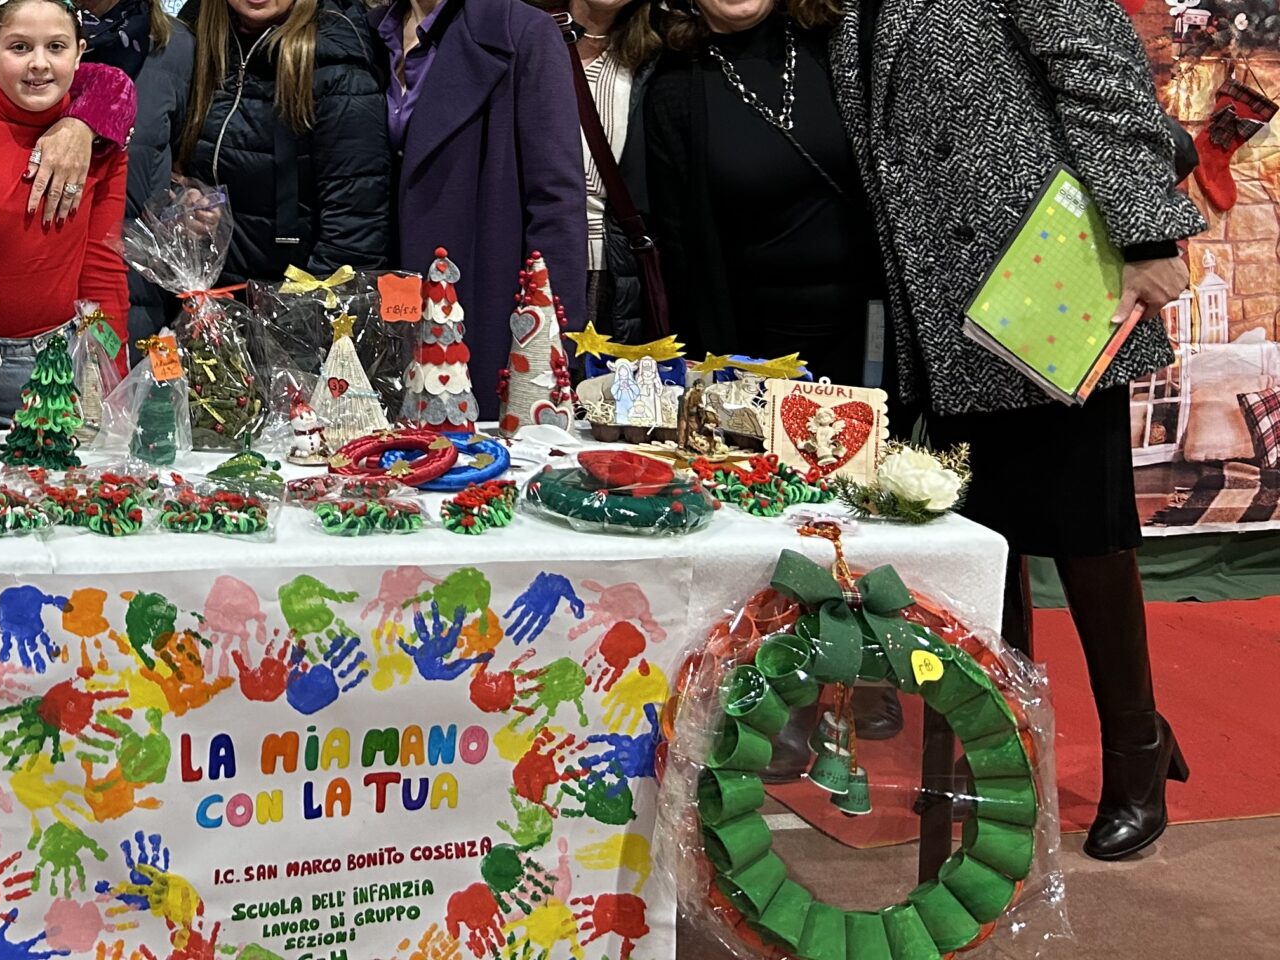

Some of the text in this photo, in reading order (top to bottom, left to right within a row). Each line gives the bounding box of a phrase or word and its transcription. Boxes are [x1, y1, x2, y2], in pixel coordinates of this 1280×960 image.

[791, 383, 853, 399] AUGURI
[180, 732, 237, 782] LA
[361, 724, 489, 768] MANO
[195, 772, 459, 828] CON LA TUA
[244, 863, 278, 883] SAN
[286, 857, 342, 877] MARCO
[410, 836, 493, 862] COSENZA
[231, 896, 303, 921] SCUOLA
[311, 890, 347, 911] DELL'
[262, 917, 320, 939] LAVORO
[354, 904, 422, 927] GRUPPO
